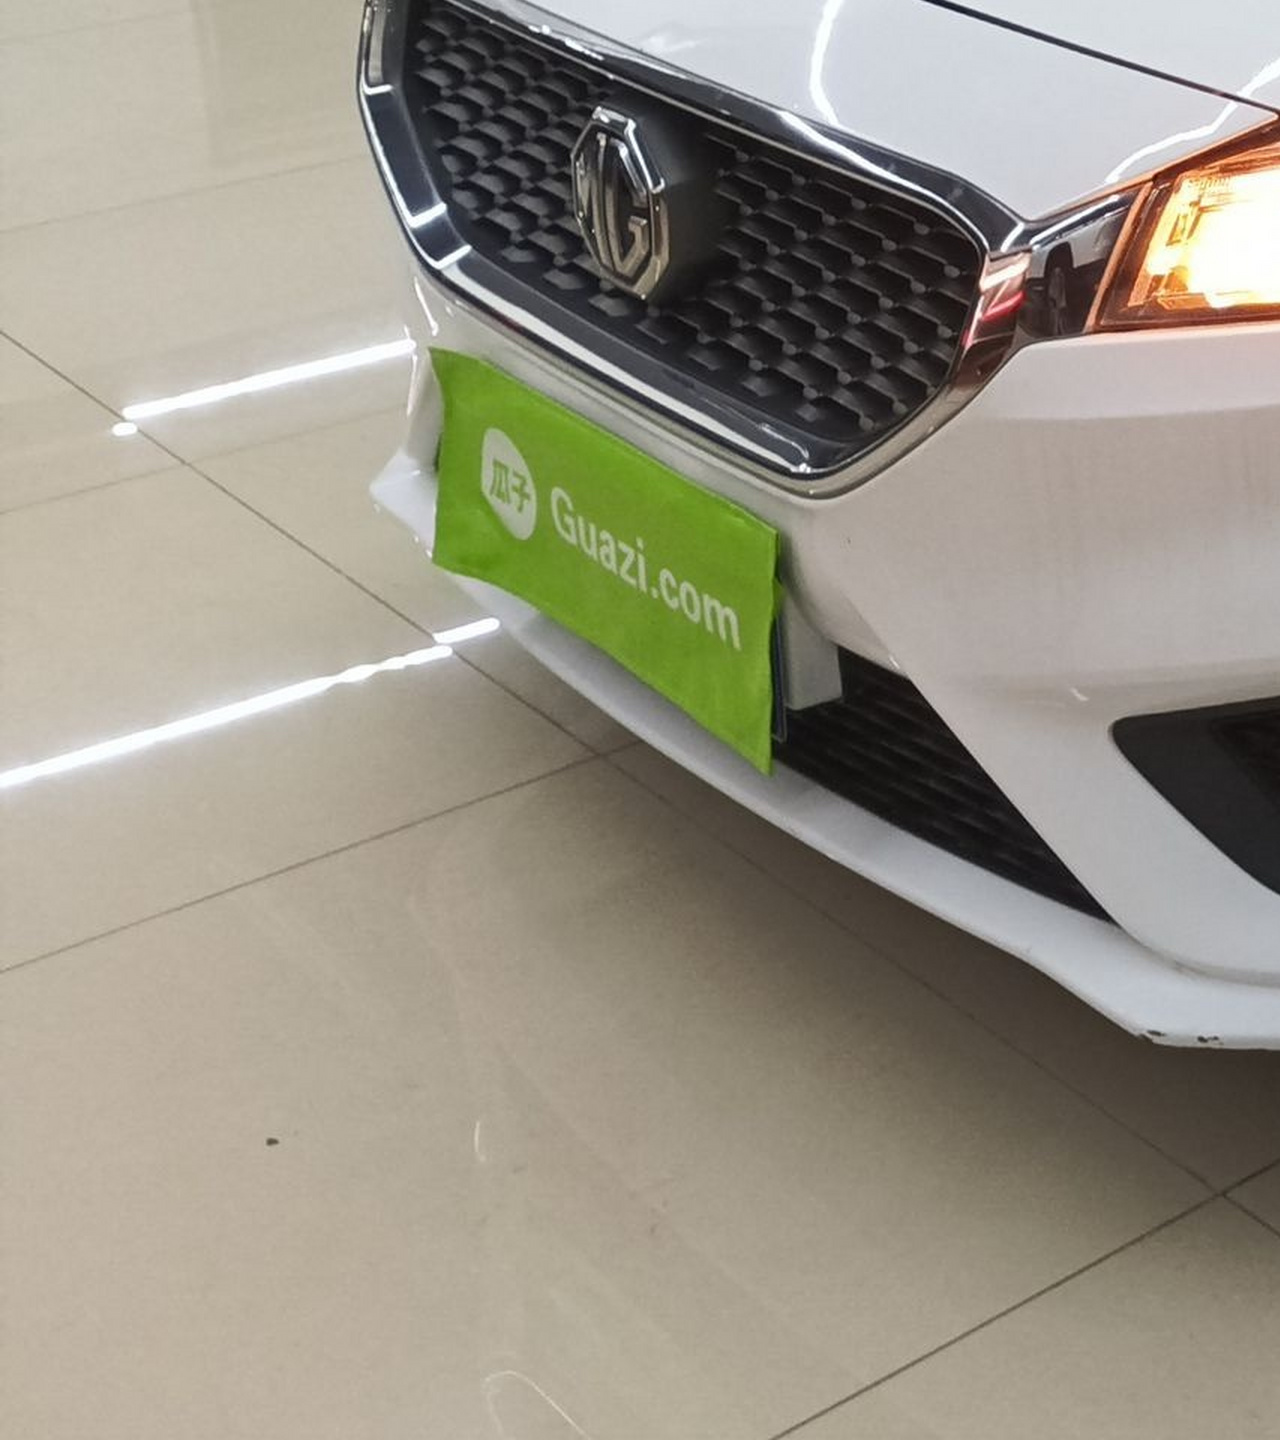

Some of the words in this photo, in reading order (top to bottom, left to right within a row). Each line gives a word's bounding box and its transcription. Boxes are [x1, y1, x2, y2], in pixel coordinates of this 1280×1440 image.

[571, 126, 655, 284] MG
[490, 458, 532, 516] 瓜子
[550, 486, 742, 651] Guazi.com
